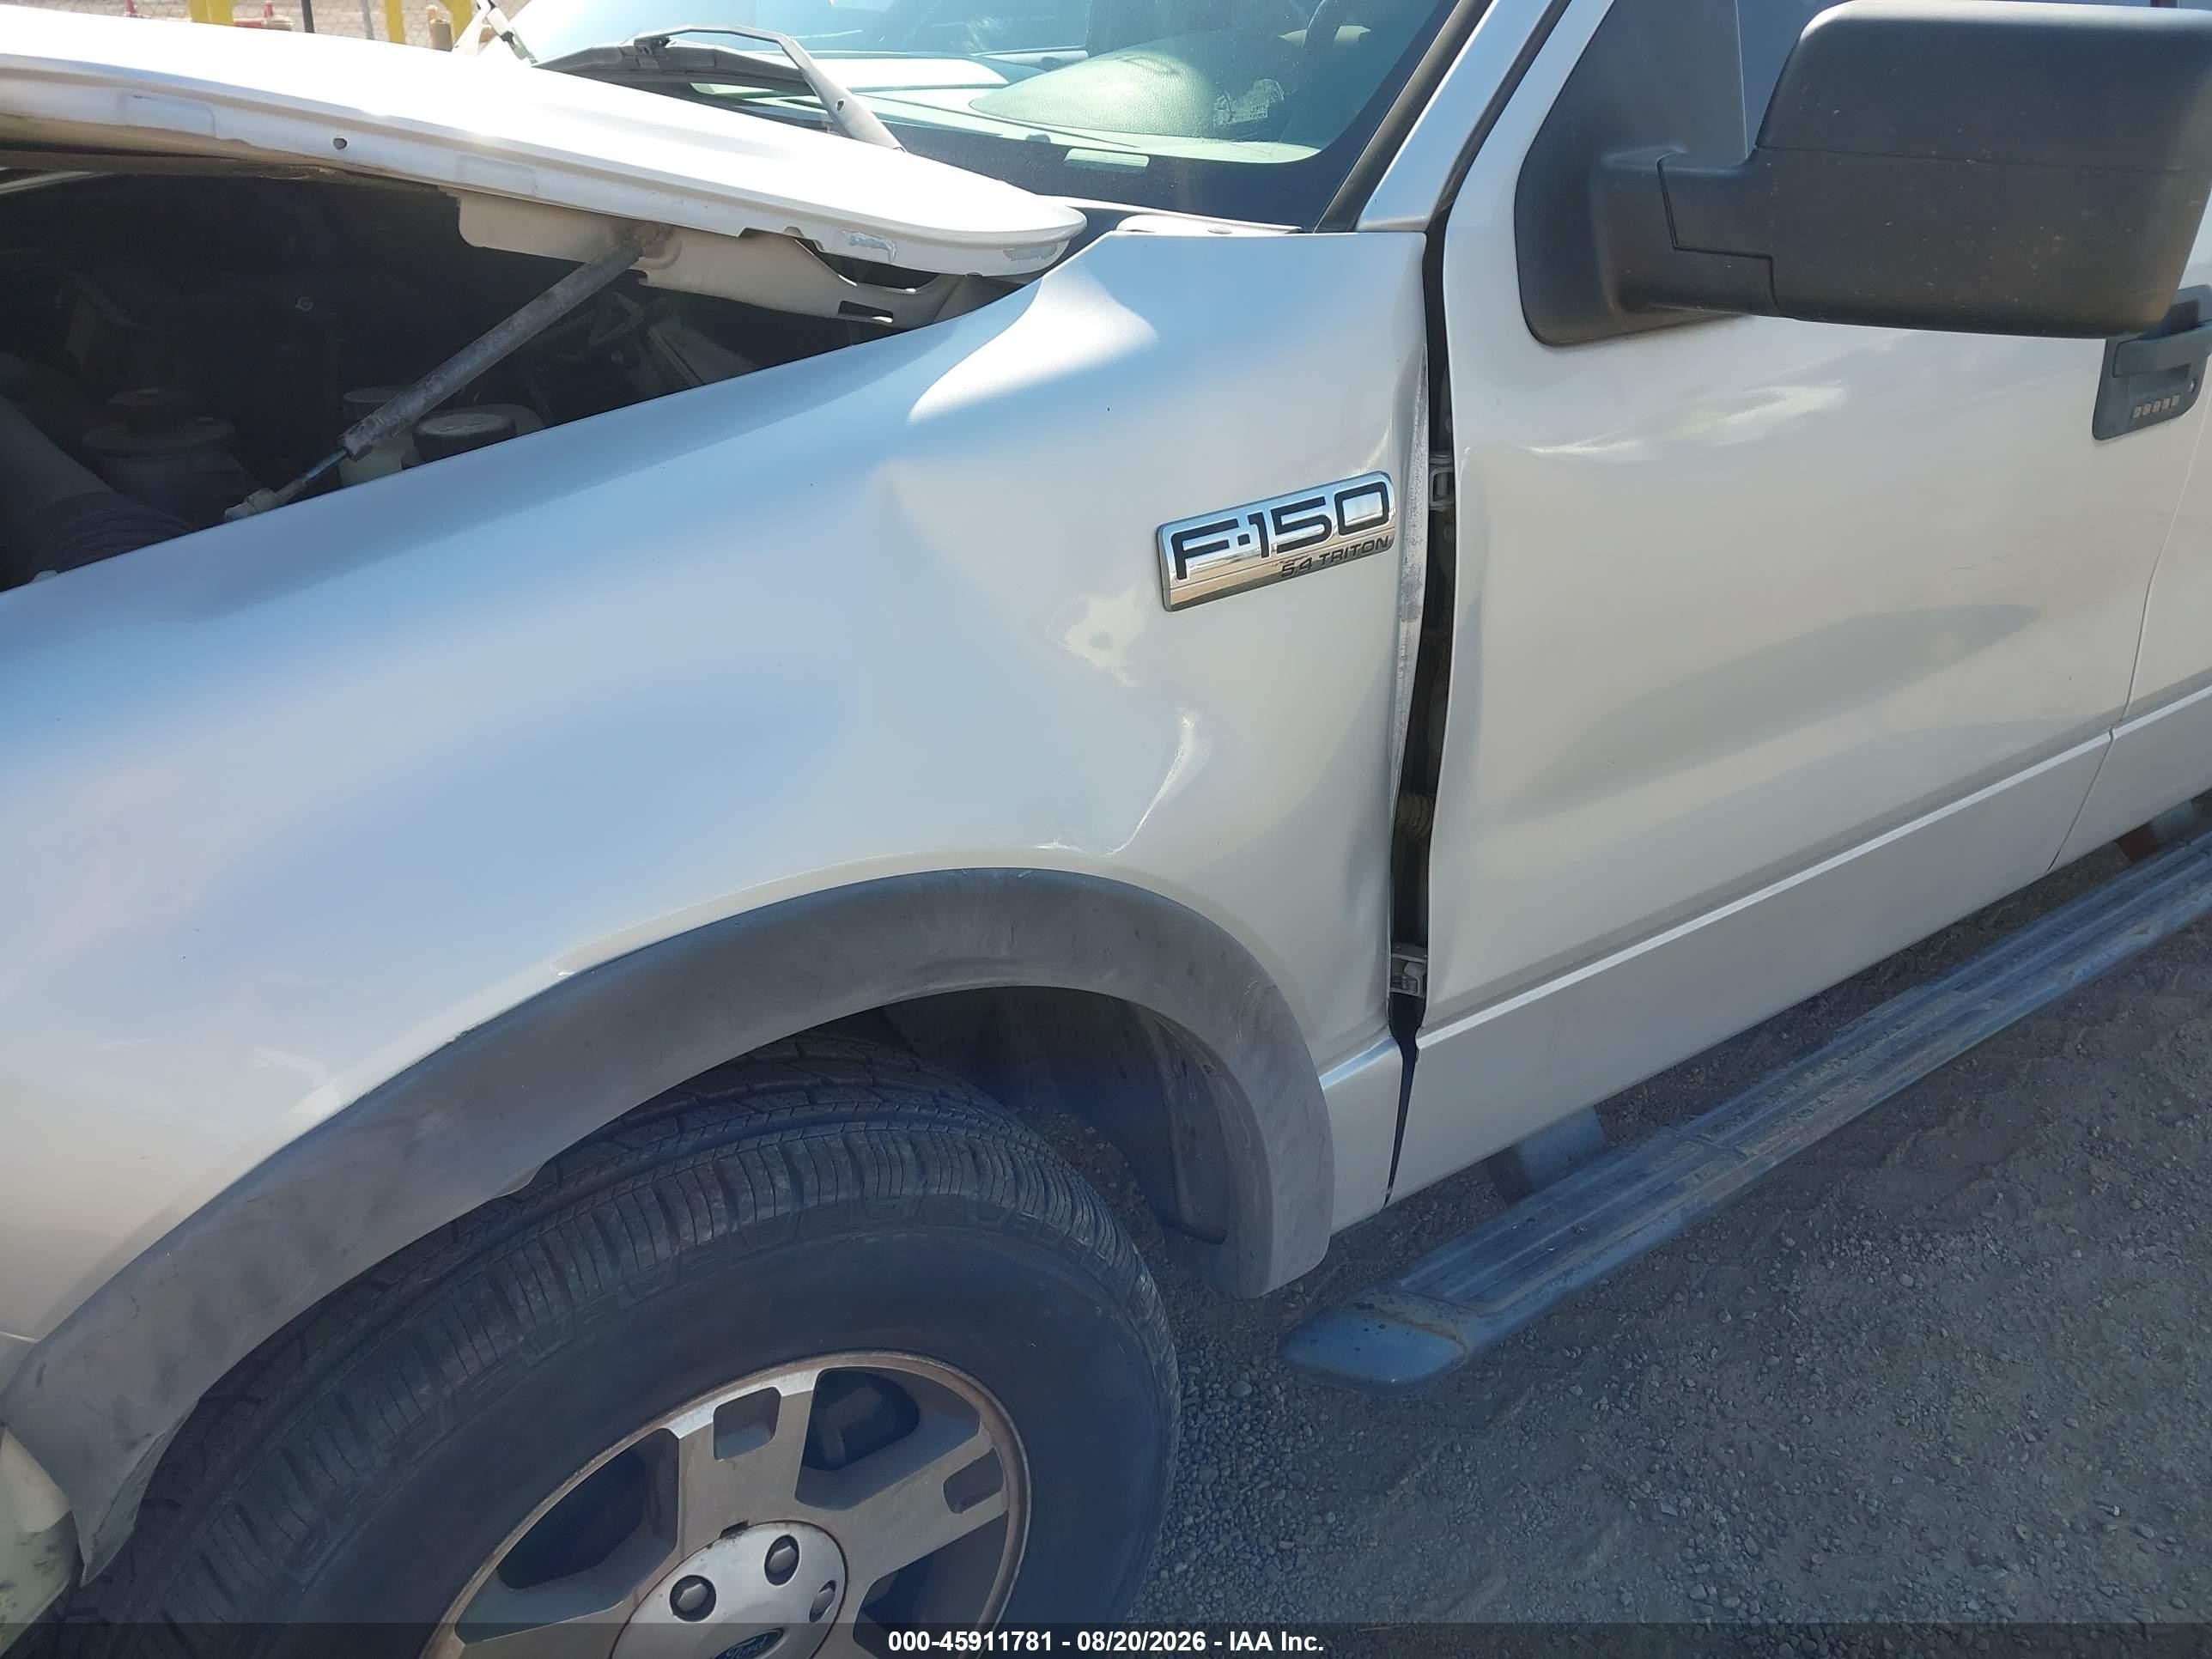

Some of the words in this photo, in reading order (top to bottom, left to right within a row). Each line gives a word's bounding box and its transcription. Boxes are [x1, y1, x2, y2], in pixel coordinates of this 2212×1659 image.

[1279, 556, 1314, 579] 5.4
[1318, 534, 1389, 566] TRITON
[725, 1634, 769, 1659] Ford
